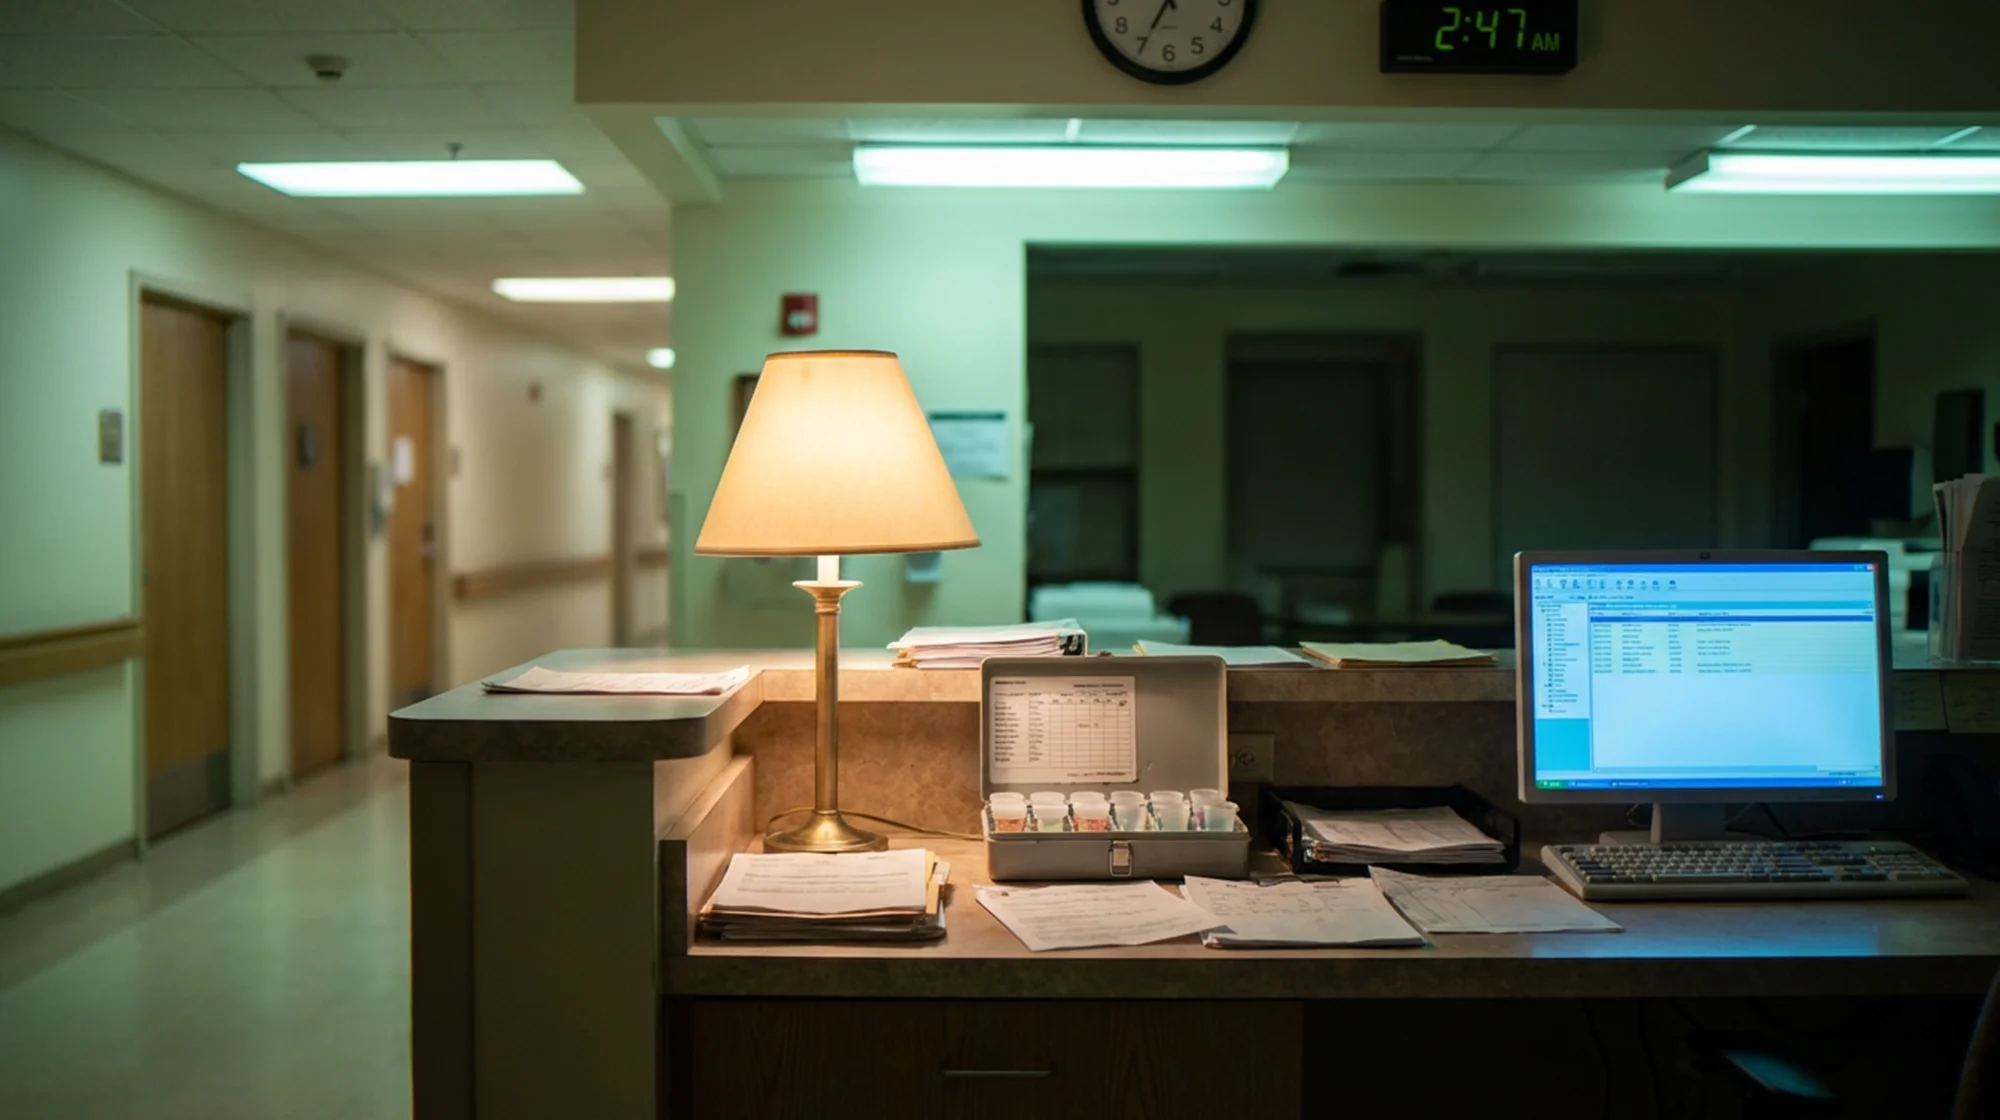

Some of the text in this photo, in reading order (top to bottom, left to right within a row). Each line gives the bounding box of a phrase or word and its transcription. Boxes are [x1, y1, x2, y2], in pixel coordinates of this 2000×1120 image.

[1115, 16, 1128, 34] 8
[1210, 17, 1222, 33] 4
[1435, 7, 1560, 51] 2:47 AM
[1136, 37, 1148, 55] 7
[1162, 44, 1176, 62] 6
[1191, 37, 1204, 54] 5
